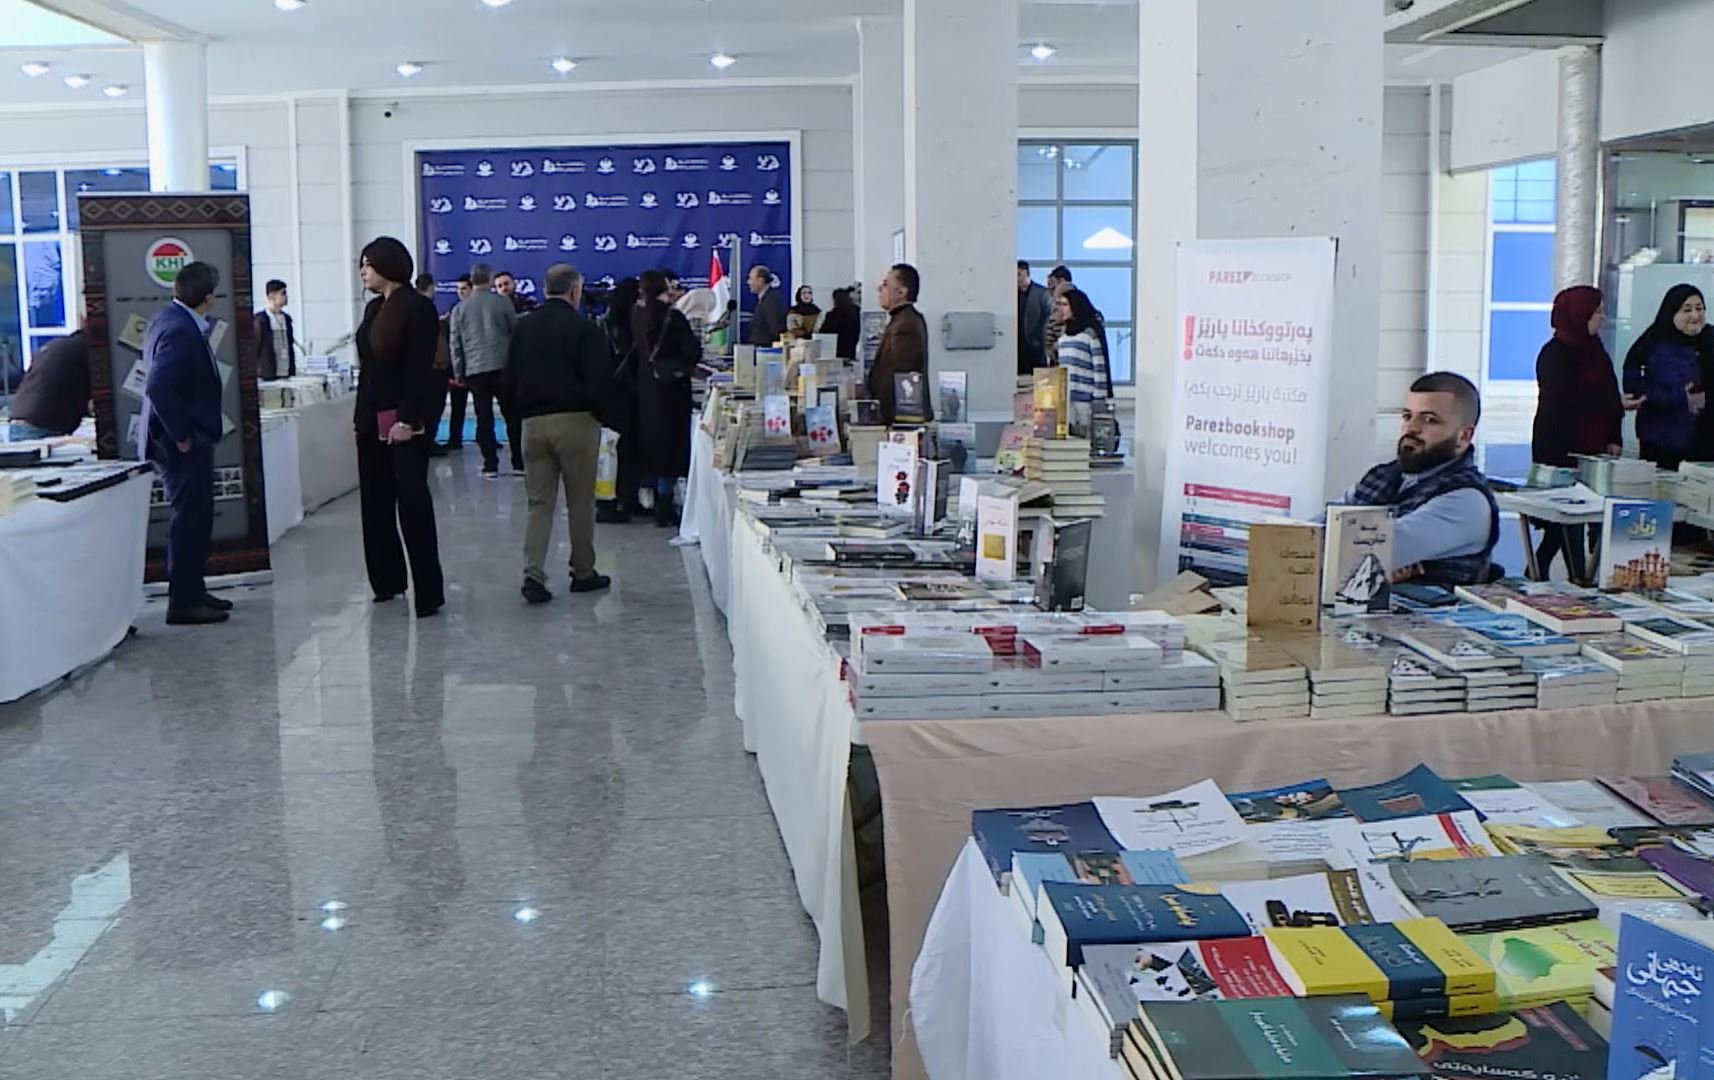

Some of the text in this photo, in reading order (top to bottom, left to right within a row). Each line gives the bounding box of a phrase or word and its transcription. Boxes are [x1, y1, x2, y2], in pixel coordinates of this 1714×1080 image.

[1185, 415, 1295, 444] Parezbookshop
[1184, 438, 1298, 467] welcomes you!
